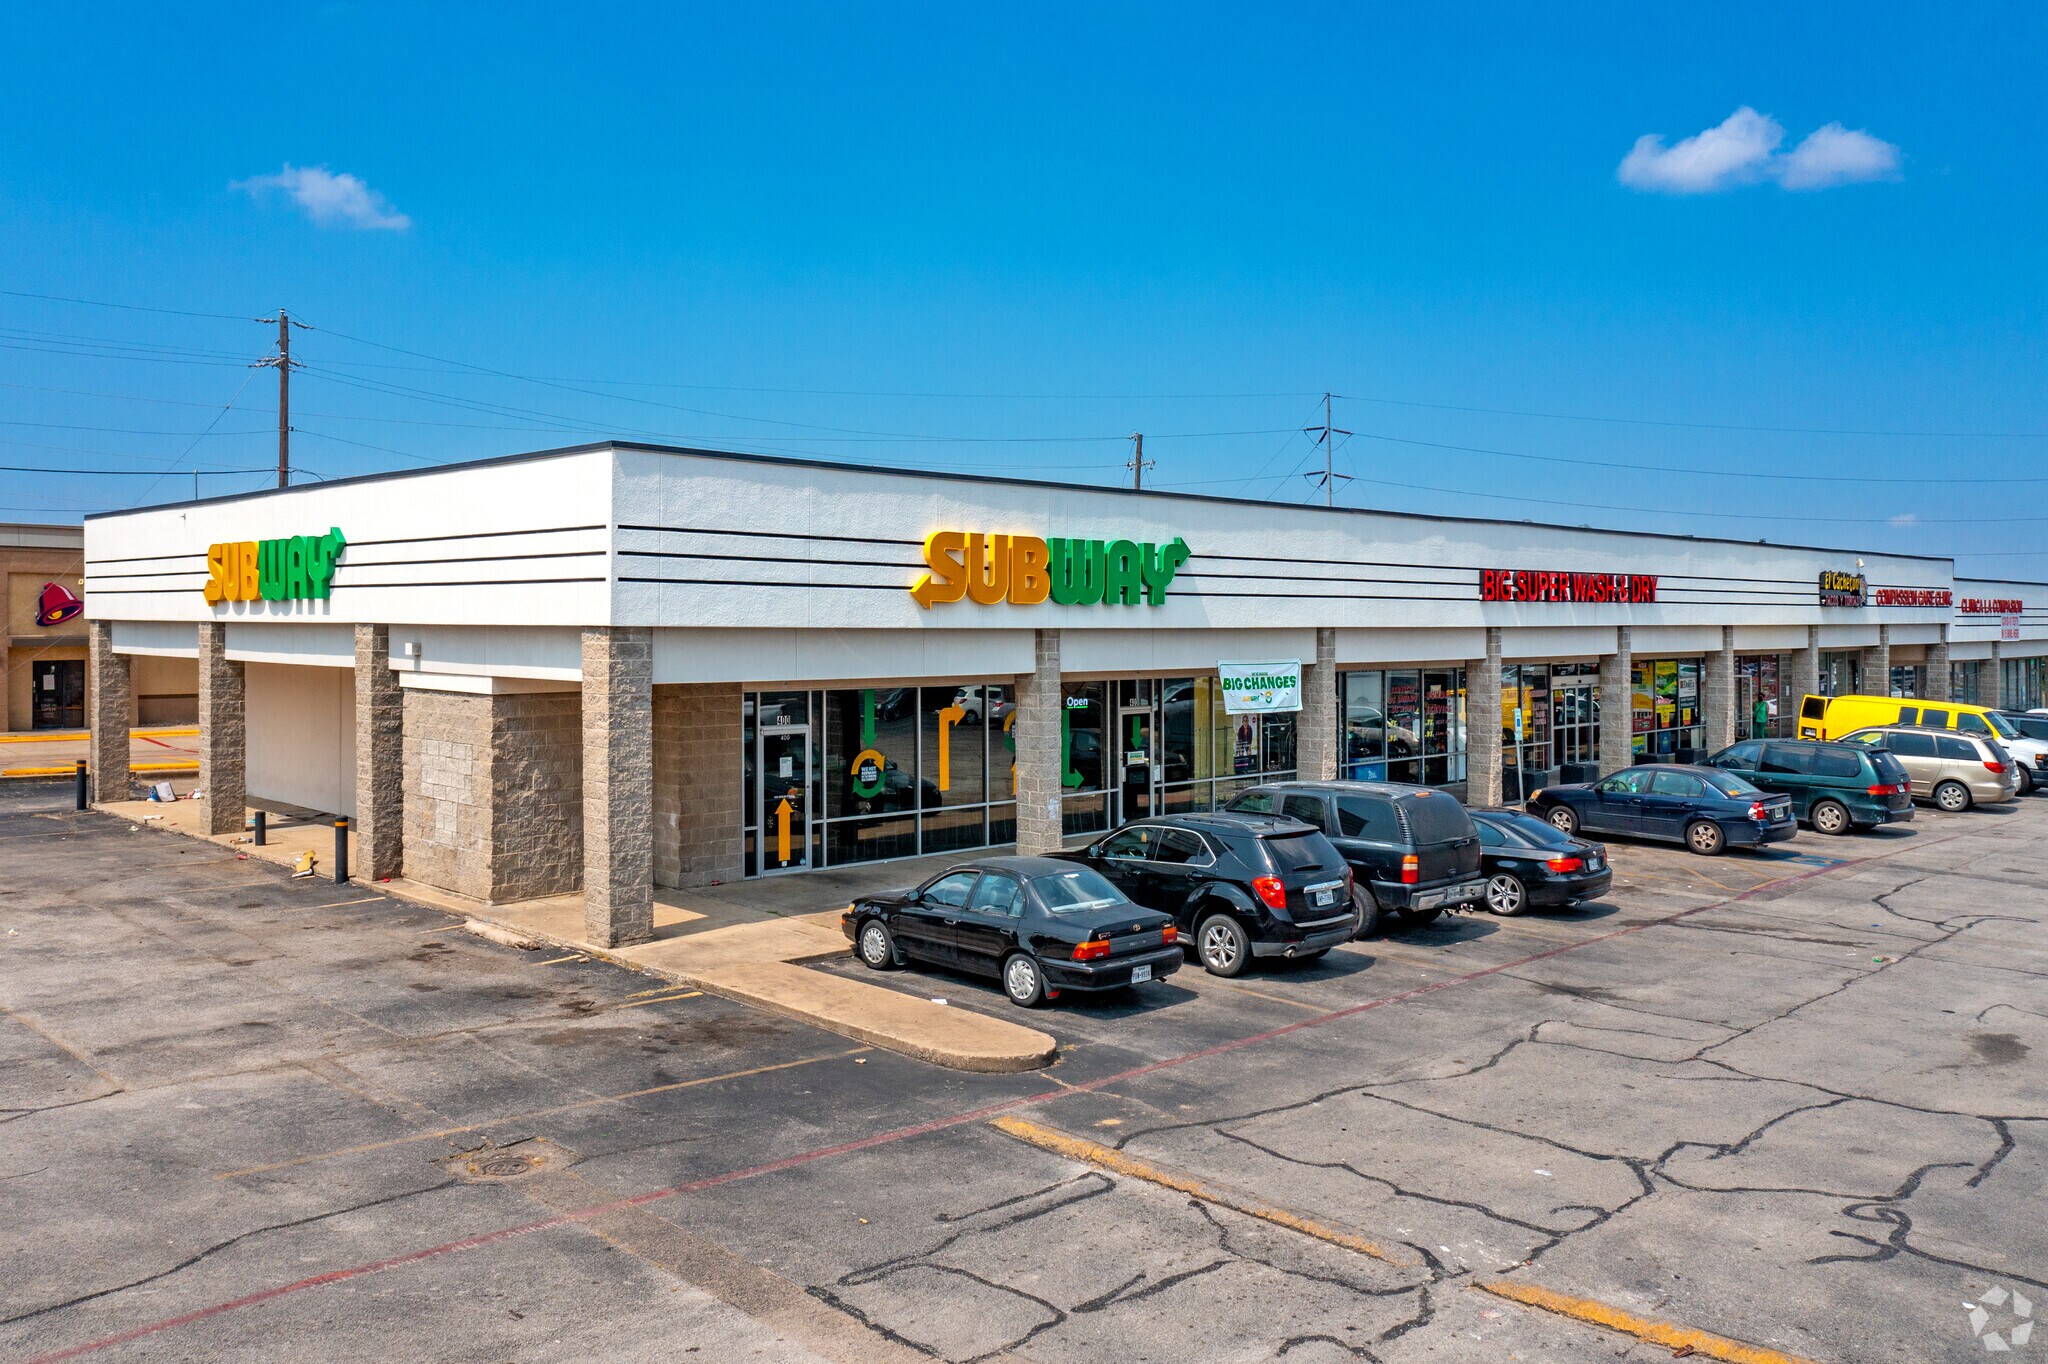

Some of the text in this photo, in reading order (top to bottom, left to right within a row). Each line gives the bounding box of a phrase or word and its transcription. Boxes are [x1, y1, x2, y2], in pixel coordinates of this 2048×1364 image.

[203, 527, 347, 607] SUBWAY
[910, 531, 1192, 610] SUBWAY
[1481, 569, 1658, 602] BIG SUPER WASH & DRY
[1876, 588, 1953, 606] COMPASSION CARE CLINIC
[1223, 675, 1296, 690] BIG CHANGES
[1067, 697, 1088, 708] Open
[777, 715, 790, 725] 400
